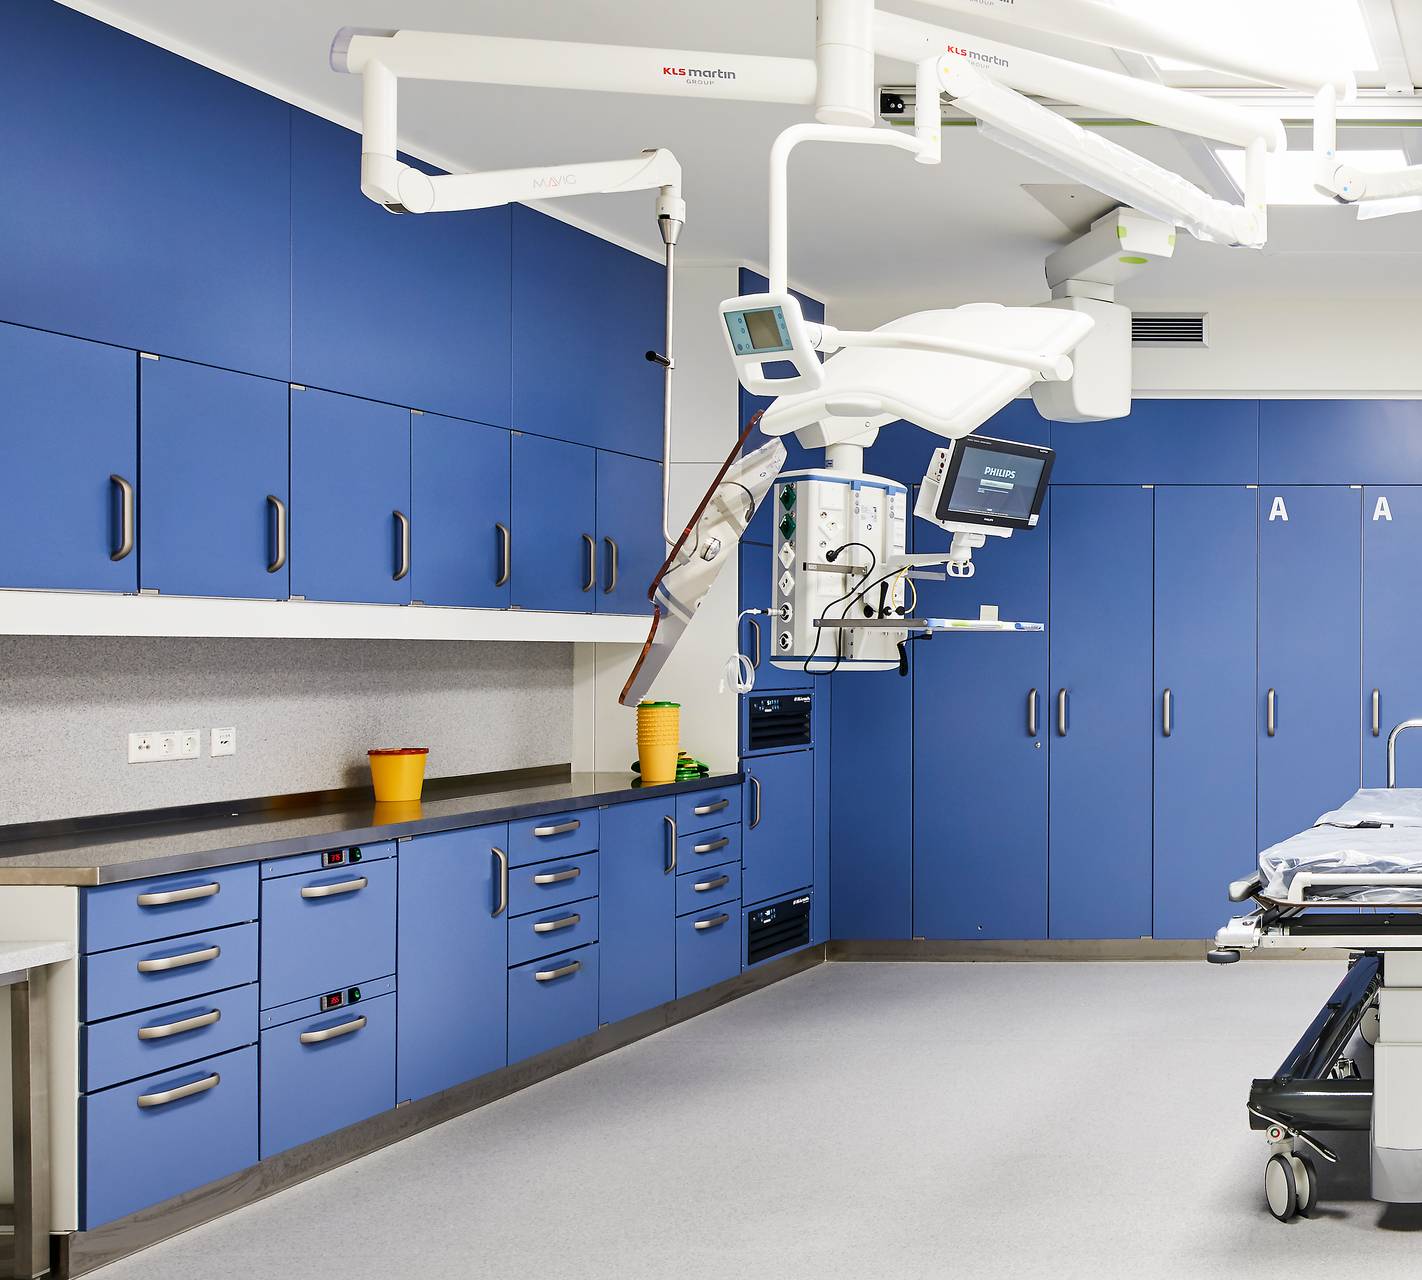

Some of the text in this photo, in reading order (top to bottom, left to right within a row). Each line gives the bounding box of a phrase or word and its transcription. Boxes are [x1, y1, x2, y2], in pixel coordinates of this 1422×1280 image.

[946, 45, 1009, 67] KLS martin
[663, 67, 736, 79] KLS martin
[984, 466, 1016, 479] PHILIPS
[1269, 497, 1288, 521] A
[1373, 497, 1392, 521] A
